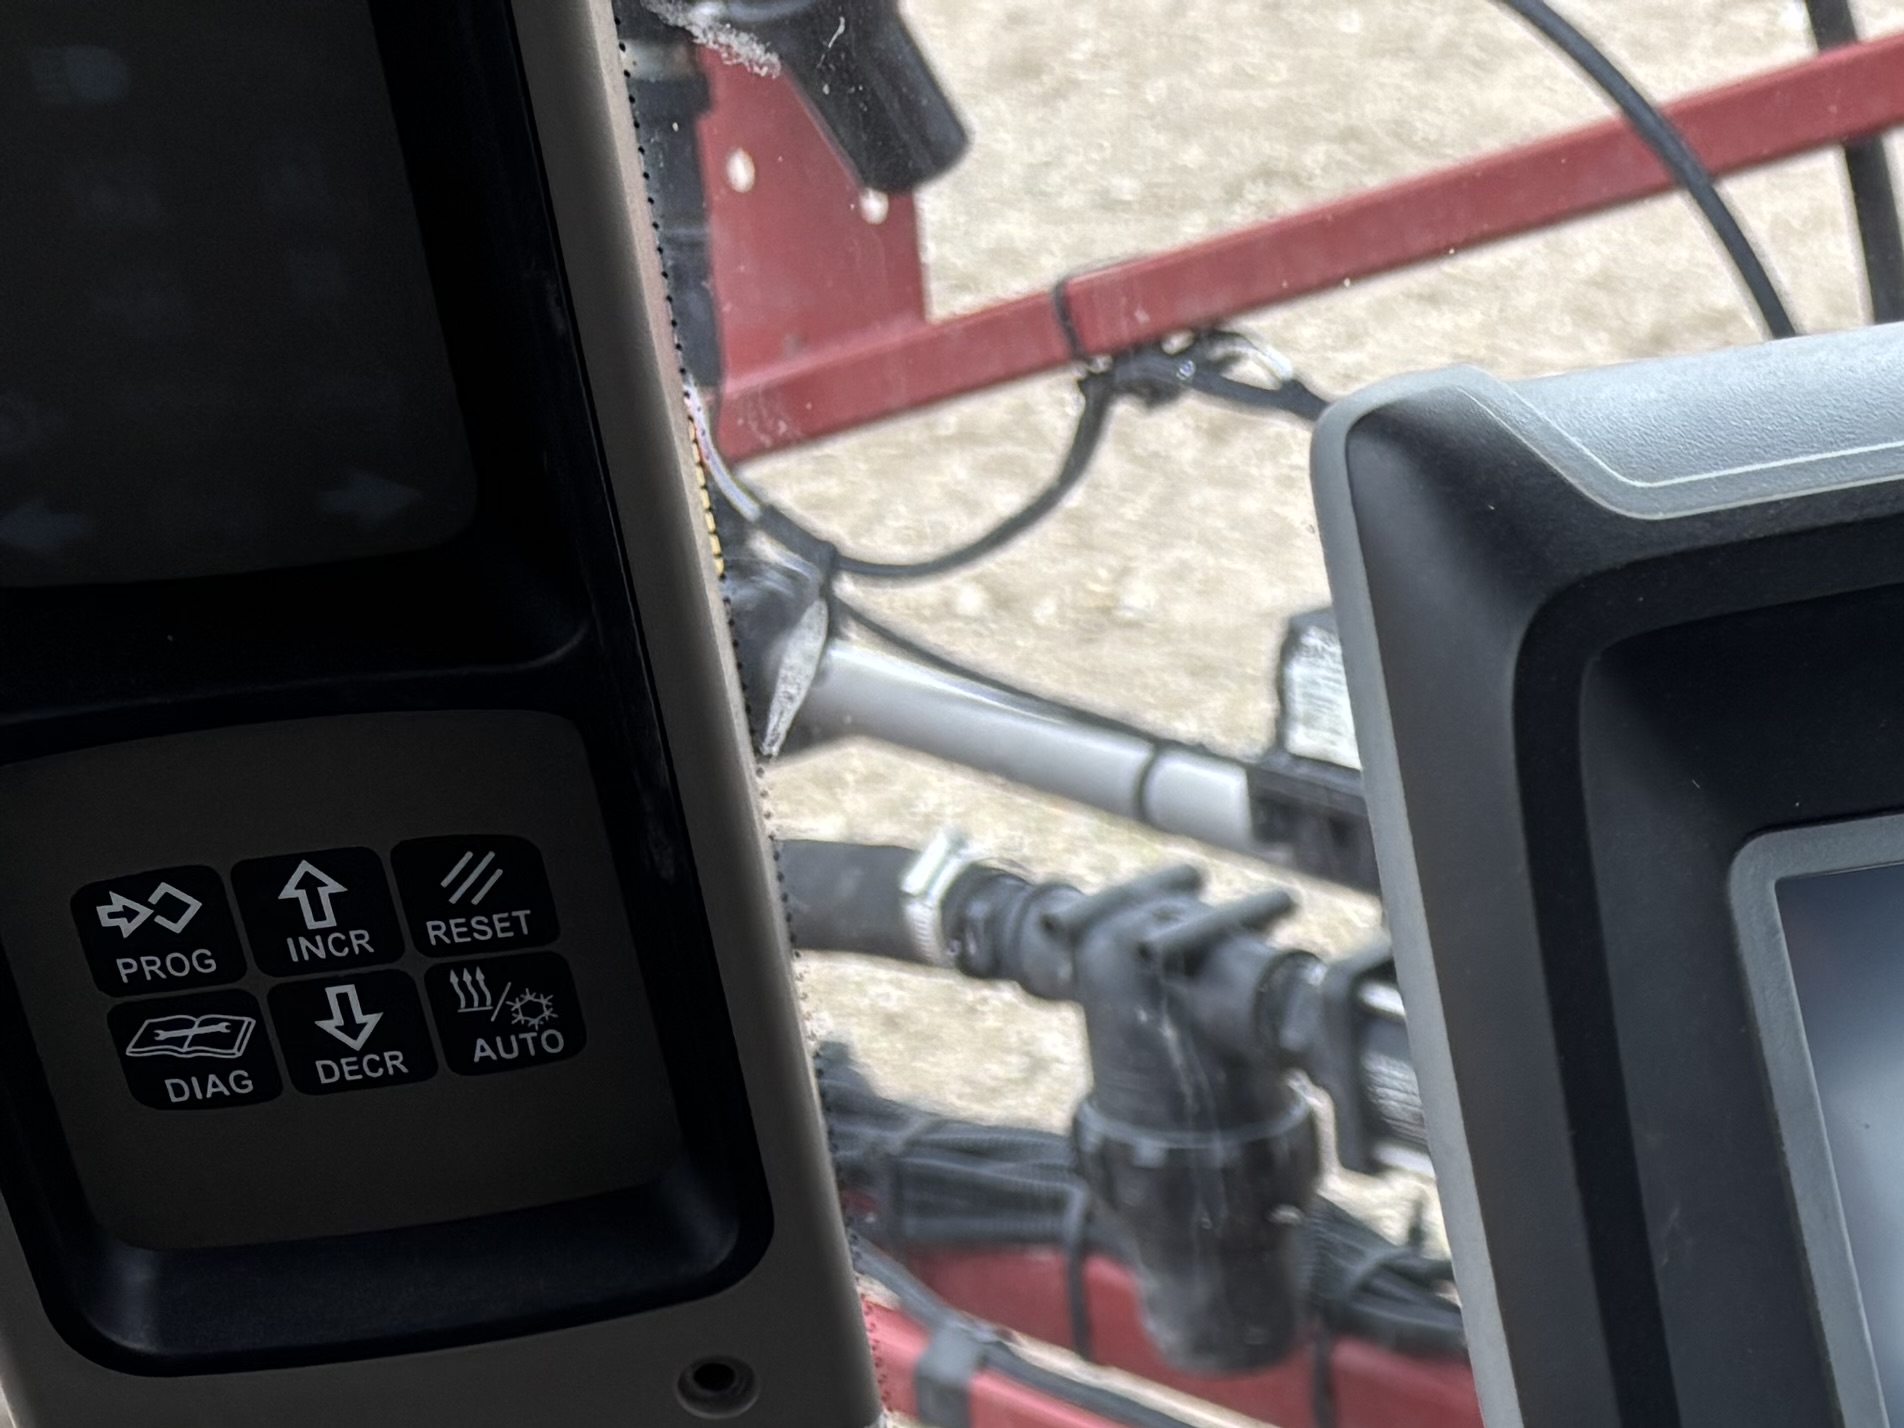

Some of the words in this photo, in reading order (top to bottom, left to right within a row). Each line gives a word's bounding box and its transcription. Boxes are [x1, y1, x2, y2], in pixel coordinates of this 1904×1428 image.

[425, 909, 532, 946] RESET
[286, 929, 375, 963] INCR
[116, 947, 217, 984] PROG
[472, 1030, 565, 1063] AUTO
[315, 1050, 409, 1085] DECR
[164, 1069, 255, 1103] DIAG
